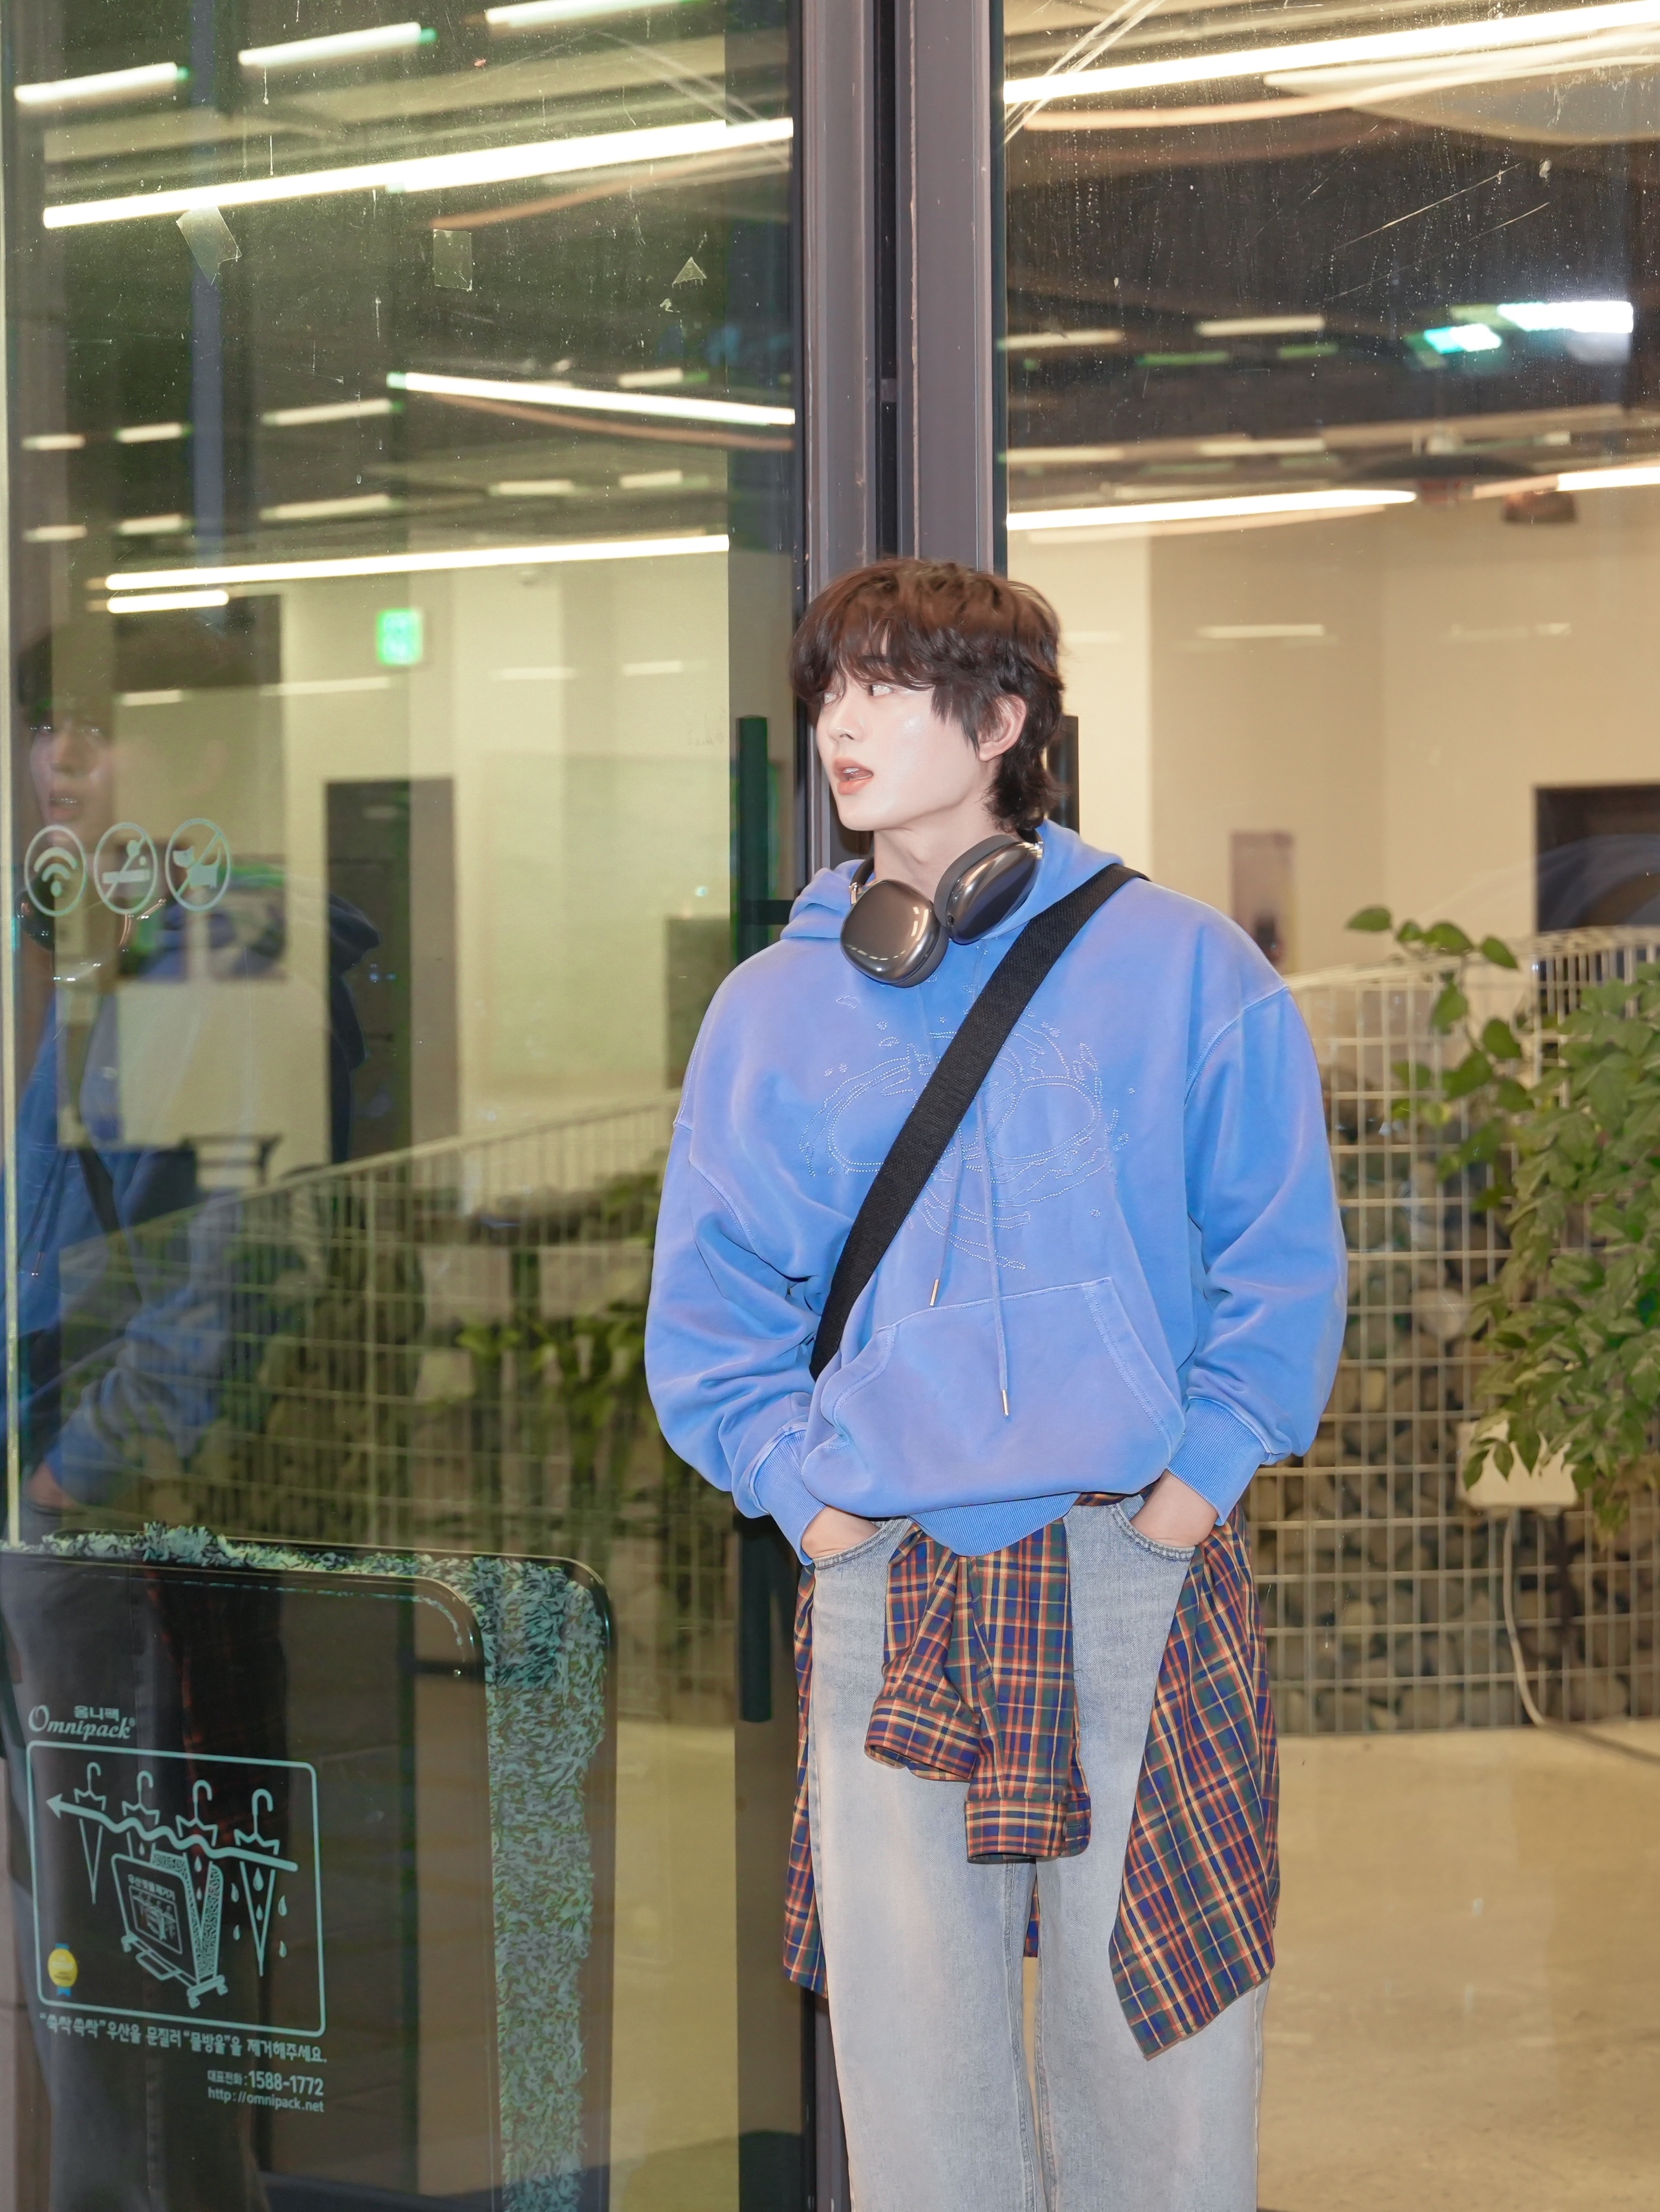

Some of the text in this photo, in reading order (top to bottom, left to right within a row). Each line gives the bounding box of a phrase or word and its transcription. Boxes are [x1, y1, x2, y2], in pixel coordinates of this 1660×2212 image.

[107, 2020, 142, 2045] 우산을
[146, 2026, 182, 2048] 문질러
[207, 2086, 324, 2113] http://omnipack.net
